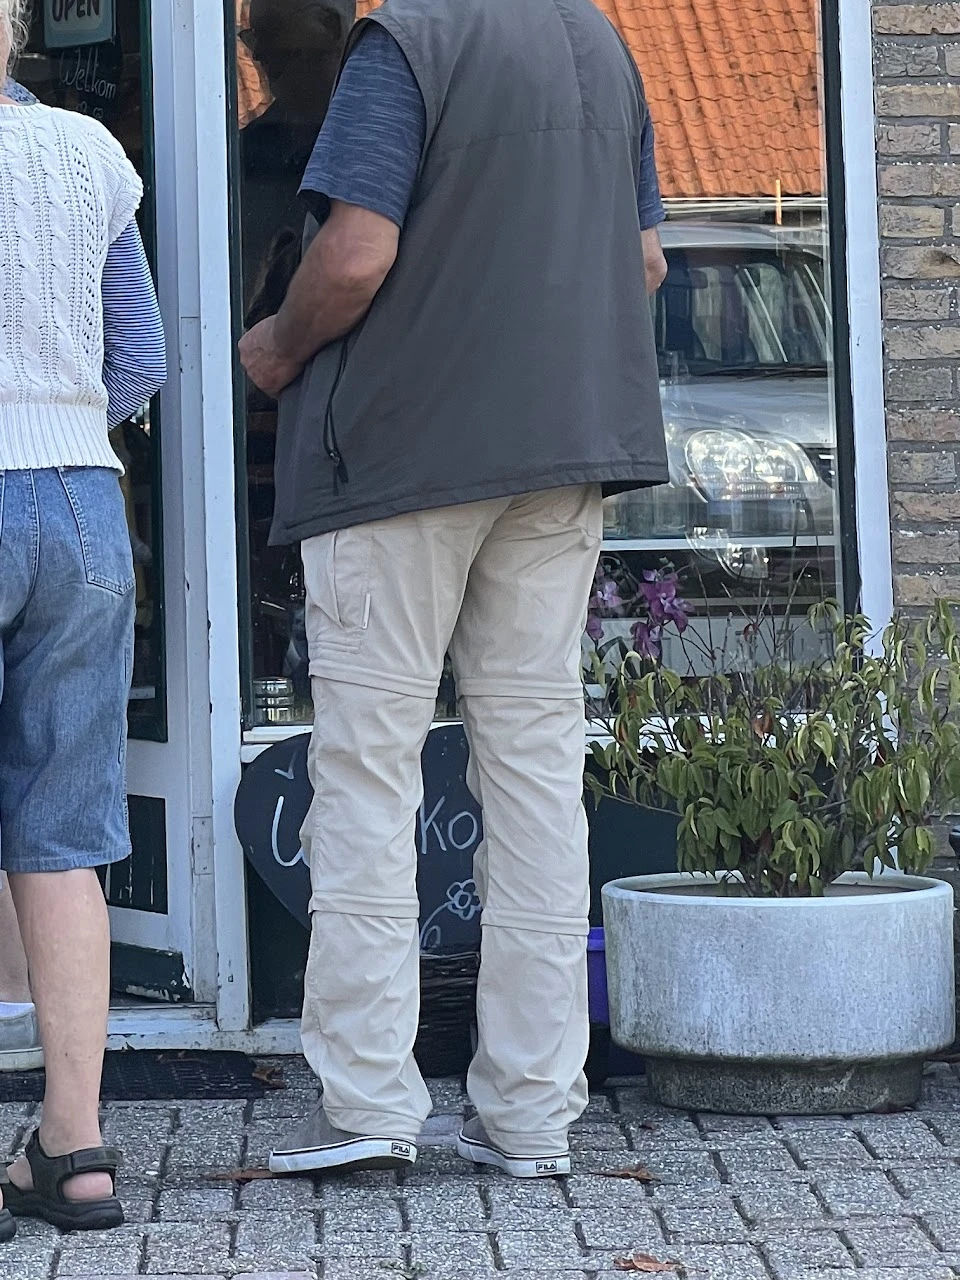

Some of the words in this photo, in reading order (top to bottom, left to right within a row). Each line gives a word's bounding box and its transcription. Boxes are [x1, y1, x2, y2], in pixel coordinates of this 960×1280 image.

[59, 47, 117, 100] Welkom
[392, 1144, 410, 1154] FILA
[537, 1162, 557, 1170] FILA
